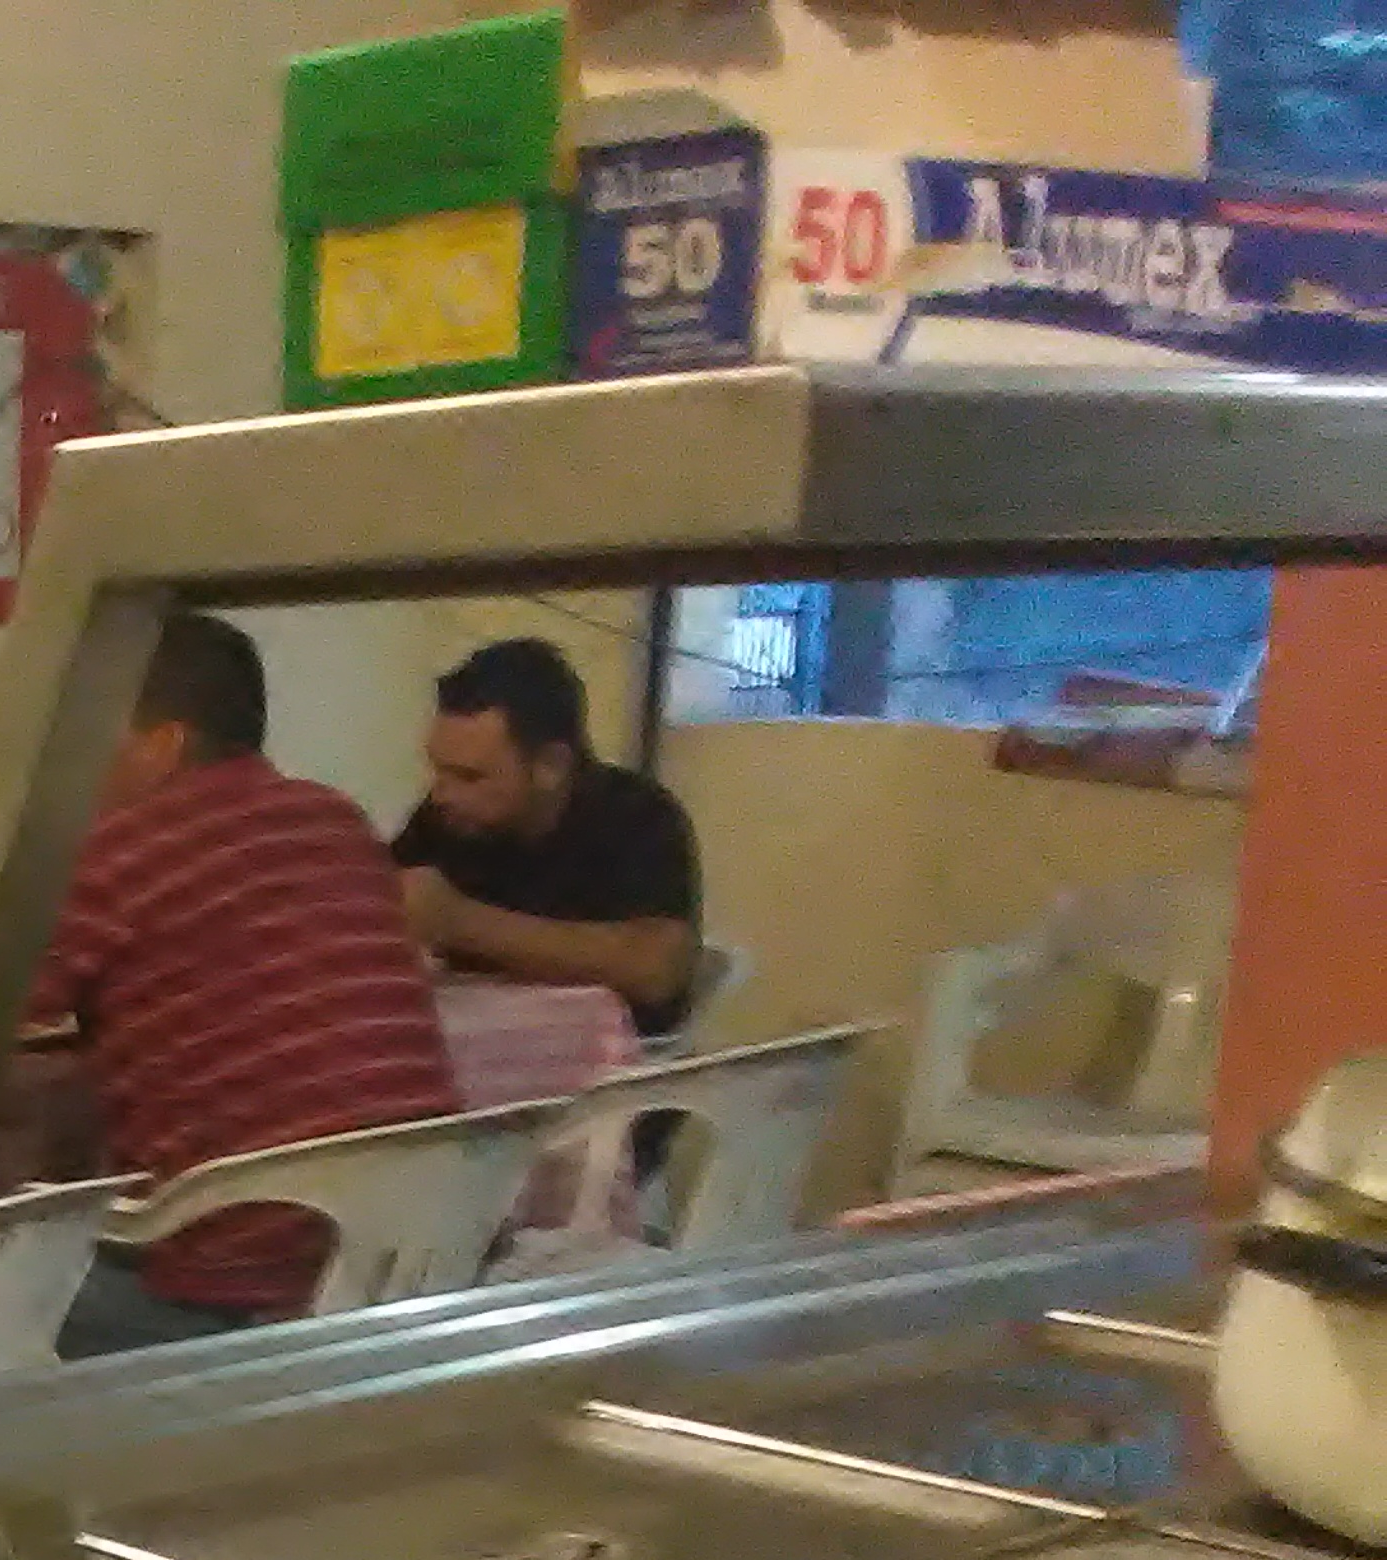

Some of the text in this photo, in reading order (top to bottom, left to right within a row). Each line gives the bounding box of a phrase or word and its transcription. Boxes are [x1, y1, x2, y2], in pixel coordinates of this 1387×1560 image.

[619, 218, 720, 298] 50
[790, 186, 887, 283] 50
[961, 173, 1234, 316] Alumex
